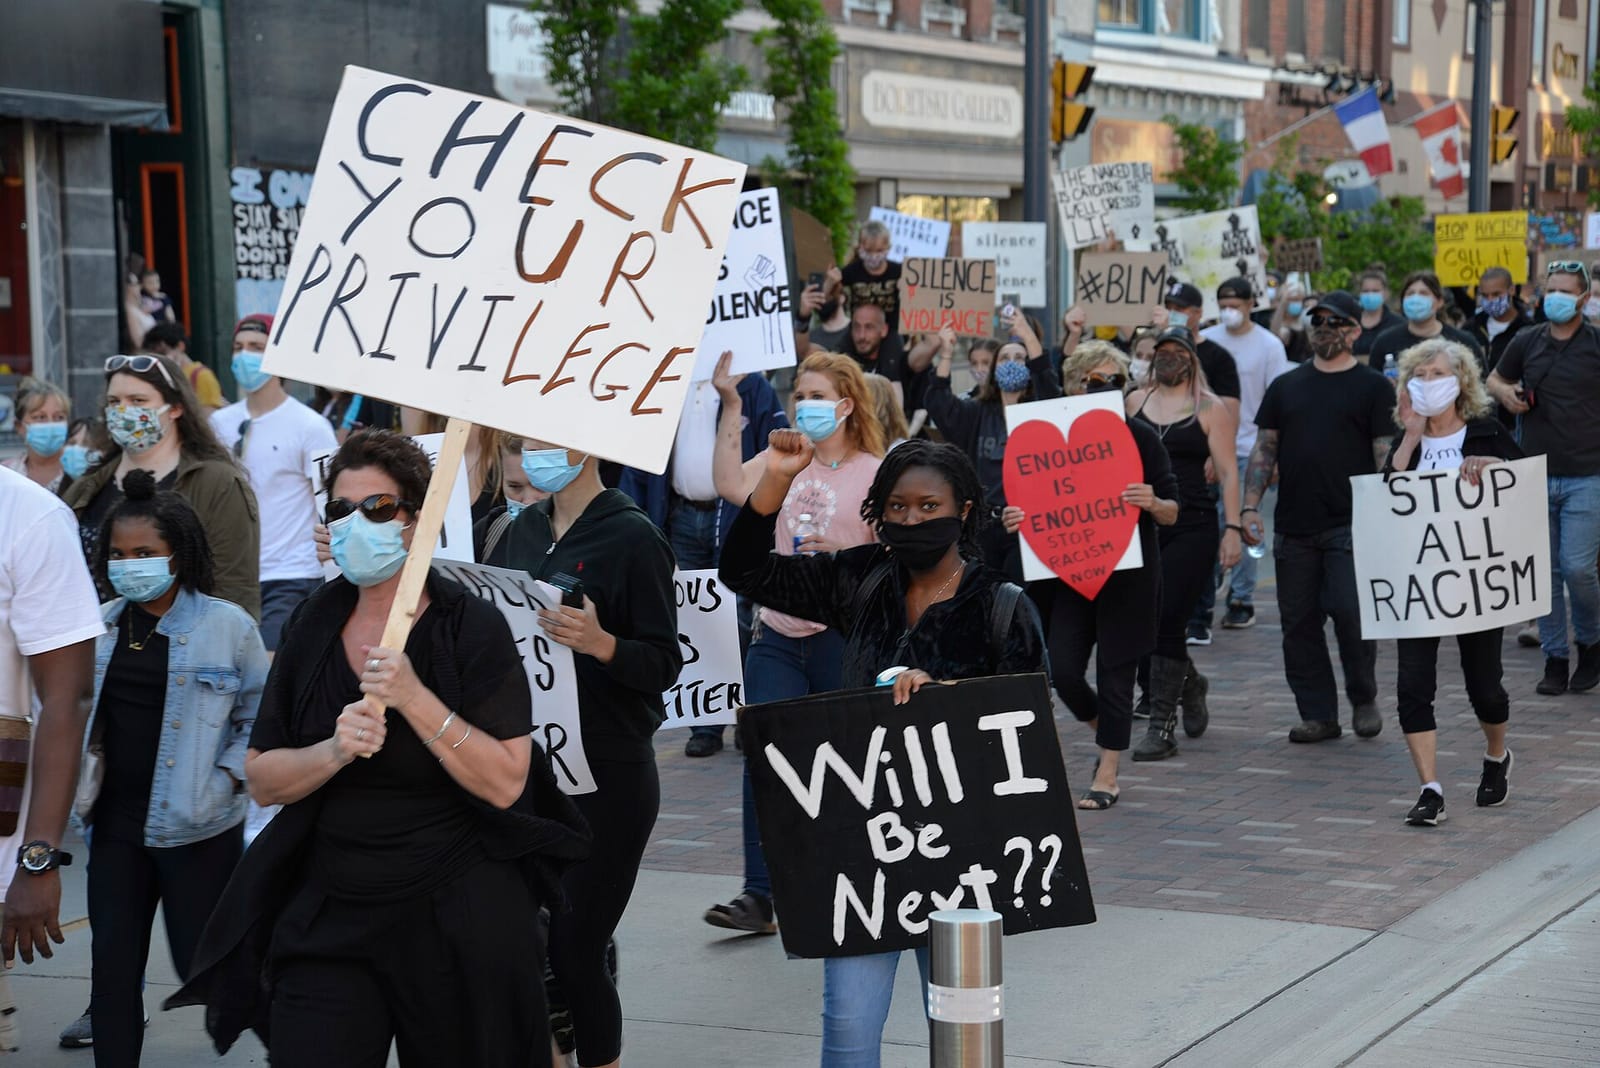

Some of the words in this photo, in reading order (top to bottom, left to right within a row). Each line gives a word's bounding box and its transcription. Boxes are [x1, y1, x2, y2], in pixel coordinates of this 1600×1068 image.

[358, 83, 736, 249] CHECK
[1060, 168, 1086, 189] THE
[230, 166, 264, 204] I
[234, 203, 272, 228] STAY
[235, 227, 287, 247] WHEN
[339, 160, 657, 321] YOUR
[976, 232, 1037, 248] silence
[905, 257, 996, 294] SILENCE
[1079, 264, 1167, 305] #BLM
[939, 291, 955, 310] IS
[273, 243, 695, 416] PRIVILEGE
[901, 307, 991, 337] VIOLENCE
[1016, 440, 1115, 477] ENOUGH
[1053, 476, 1076, 497] IS
[1387, 467, 1516, 517] STOP
[1030, 495, 1128, 534] ENOUGH
[1047, 528, 1096, 550] STOP
[1048, 540, 1115, 570] RACISM
[1416, 516, 1504, 565] ALL
[1070, 566, 1107, 583] NOW
[1370, 554, 1537, 622] RACISM
[764, 720, 966, 821] Will
[976, 710, 1050, 797] I
[866, 811, 951, 864] Be
